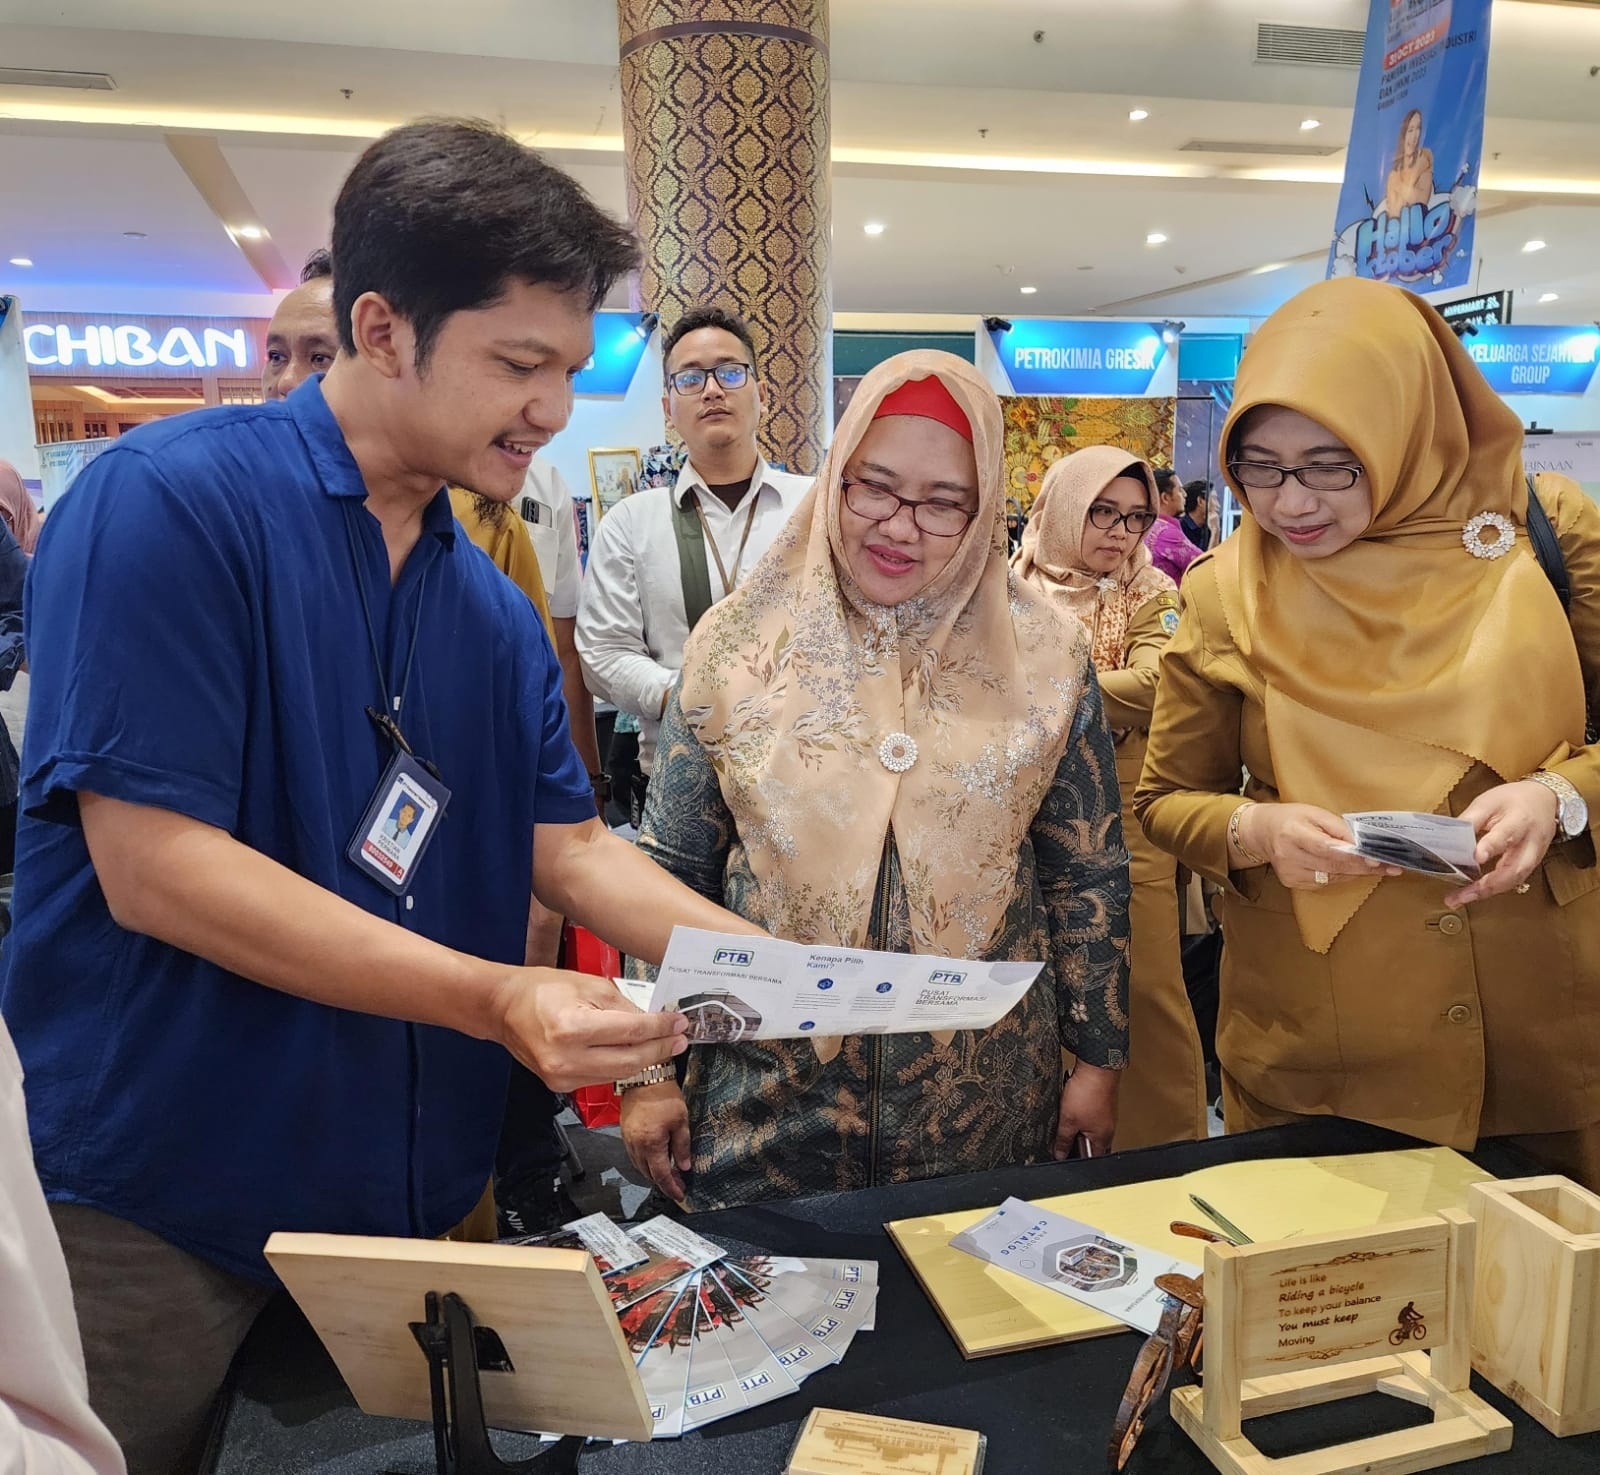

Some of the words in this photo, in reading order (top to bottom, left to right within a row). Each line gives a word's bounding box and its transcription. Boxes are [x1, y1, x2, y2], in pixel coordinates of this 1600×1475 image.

[23, 324, 247, 367] CHIBAN
[1468, 344, 1528, 363] KELUARGA
[1014, 347, 1101, 370] PETROKIMIA
[1105, 347, 1155, 370] GRESIK
[1511, 365, 1550, 385] GROUP
[717, 951, 749, 963] PTB
[807, 962, 835, 970] Kami?
[809, 954, 842, 964] Kenapa
[845, 957, 864, 965] Pilih
[668, 966, 691, 974] PUSAT
[749, 974, 782, 985] BERSAMA
[932, 972, 961, 983] PTB
[1000, 1220, 1047, 1255] CATALOG
[1279, 1279, 1297, 1288] Life
[1300, 1276, 1307, 1285] is
[1310, 1273, 1327, 1284] like
[835, 1291, 855, 1310] PTB
[1279, 1290, 1314, 1302] Riding
[1329, 1281, 1364, 1295] bicycle
[1278, 1308, 1291, 1317] To
[1294, 1304, 1317, 1315] keep
[1320, 1302, 1342, 1313] your
[1344, 1295, 1382, 1307] balance
[812, 1318, 838, 1338] PTB
[1278, 1322, 1298, 1332] You
[1302, 1317, 1330, 1328] must
[1333, 1313, 1359, 1324] keep
[1278, 1335, 1315, 1347] Moving
[779, 1347, 809, 1365] PTB
[690, 1388, 721, 1405] PTB
